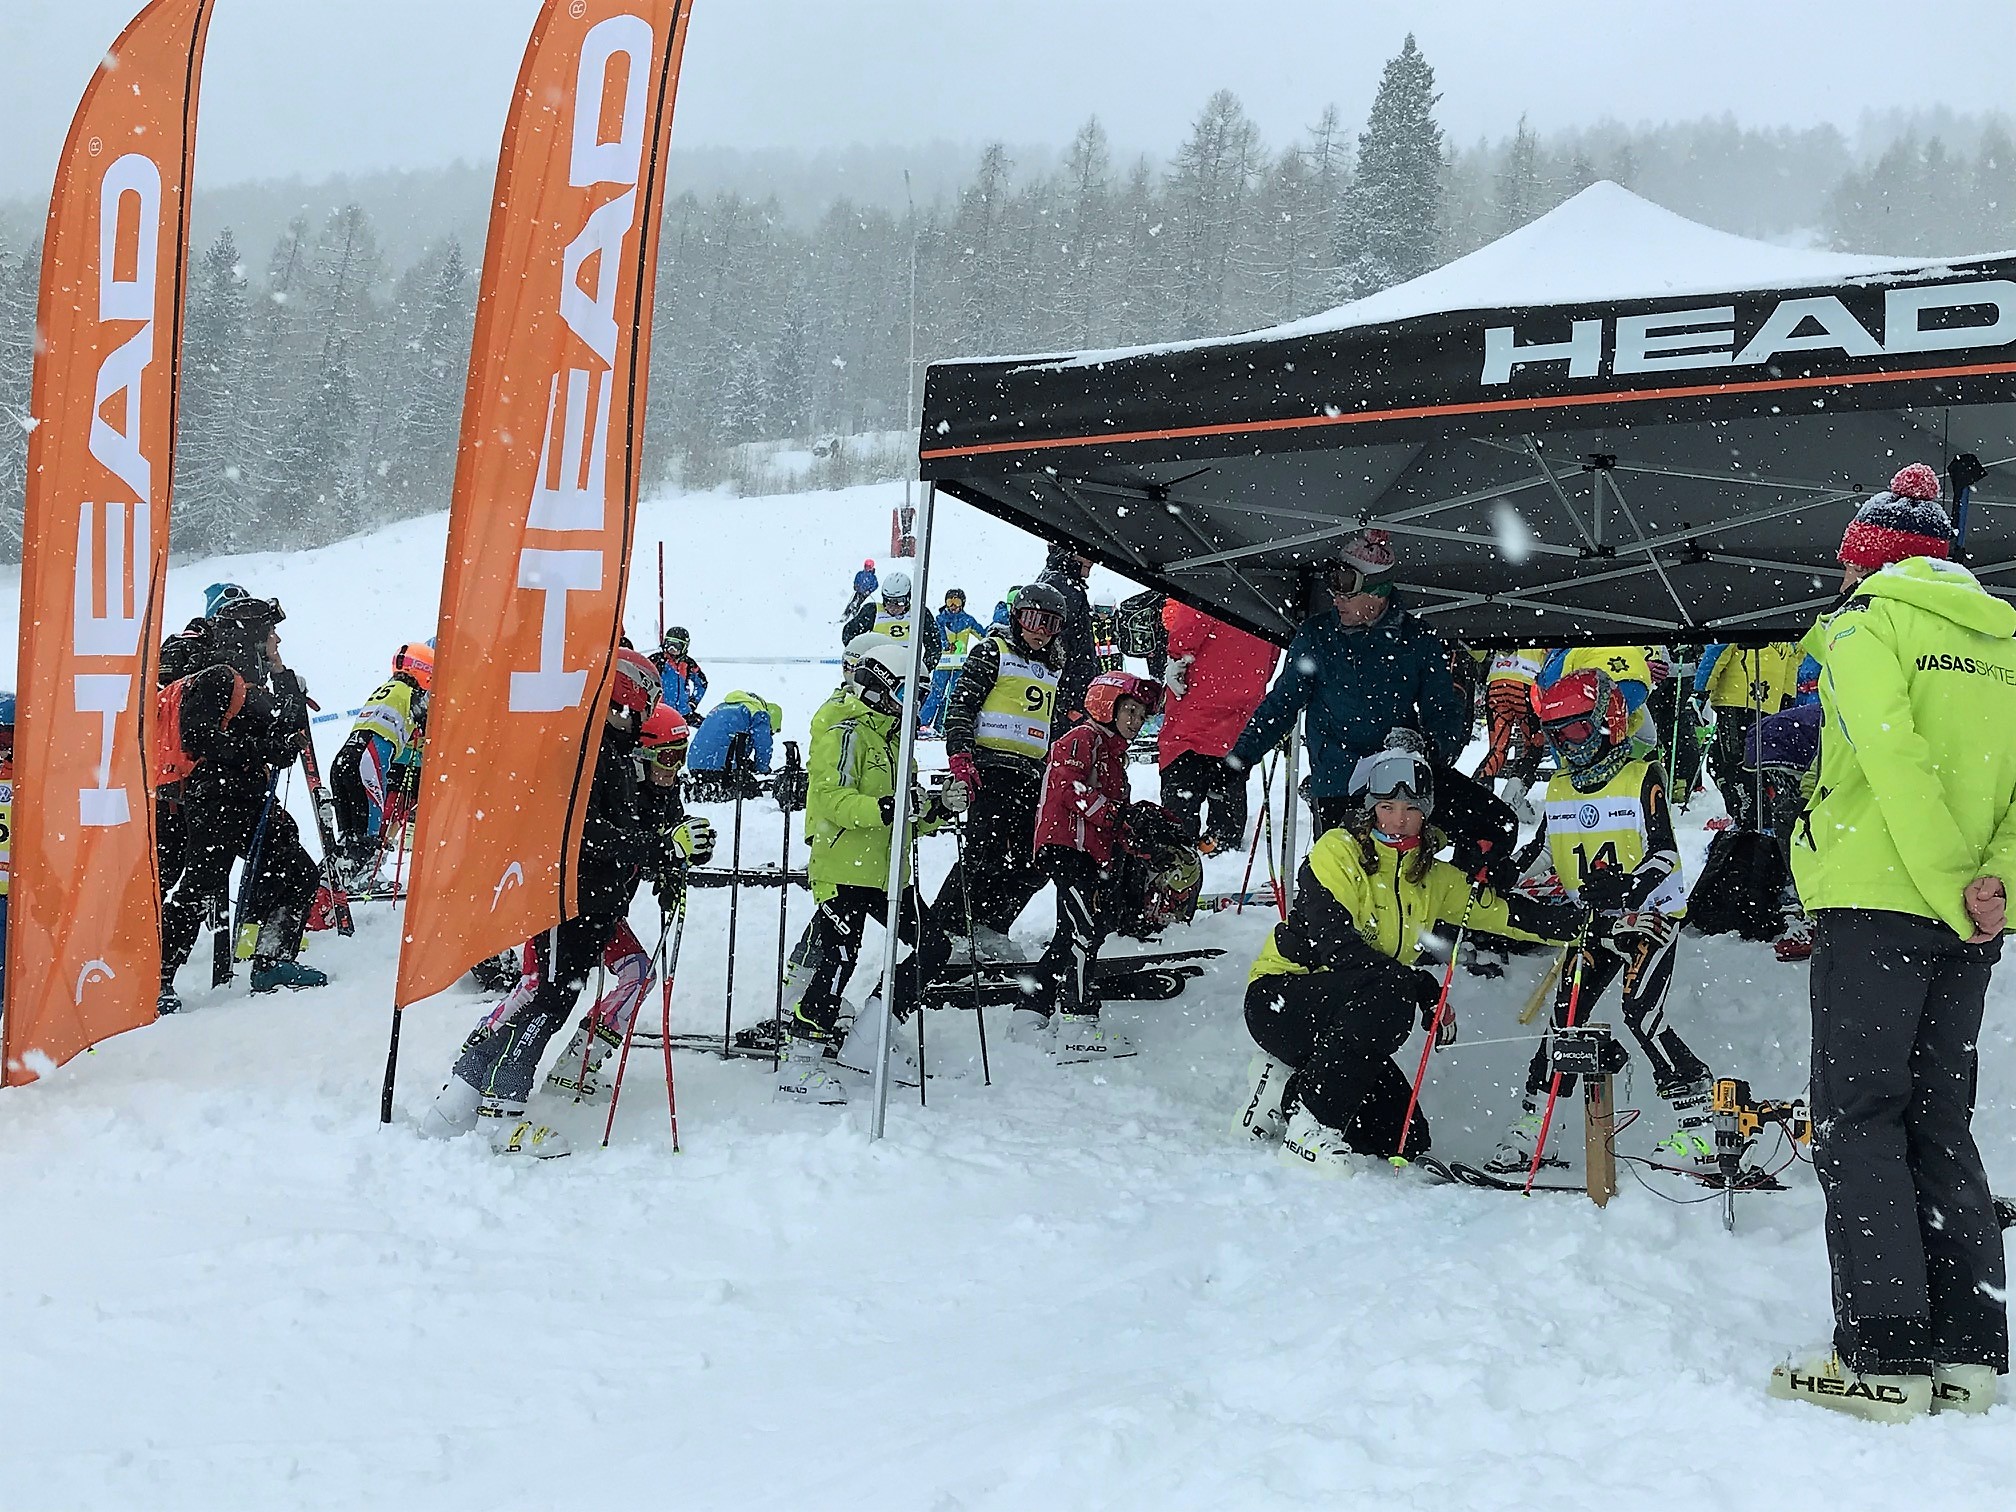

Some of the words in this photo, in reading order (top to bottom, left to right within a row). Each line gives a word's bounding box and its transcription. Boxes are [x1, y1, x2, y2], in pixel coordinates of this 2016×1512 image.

[1480, 279, 2016, 386] HEAD
[509, 14, 654, 713] HEAD
[74, 152, 162, 827] HEAD
[1915, 653, 2016, 686] VASASSKITE
[1025, 685, 1053, 717] 91
[1572, 841, 1624, 880] 14
[820, 902, 851, 935] EAD
[547, 1074, 596, 1096] HEAD
[779, 1085, 808, 1095] HEAD
[1242, 1062, 1274, 1128] HEAD
[1282, 1137, 1317, 1163] HEAD
[1790, 1373, 1909, 1405] HEAD
